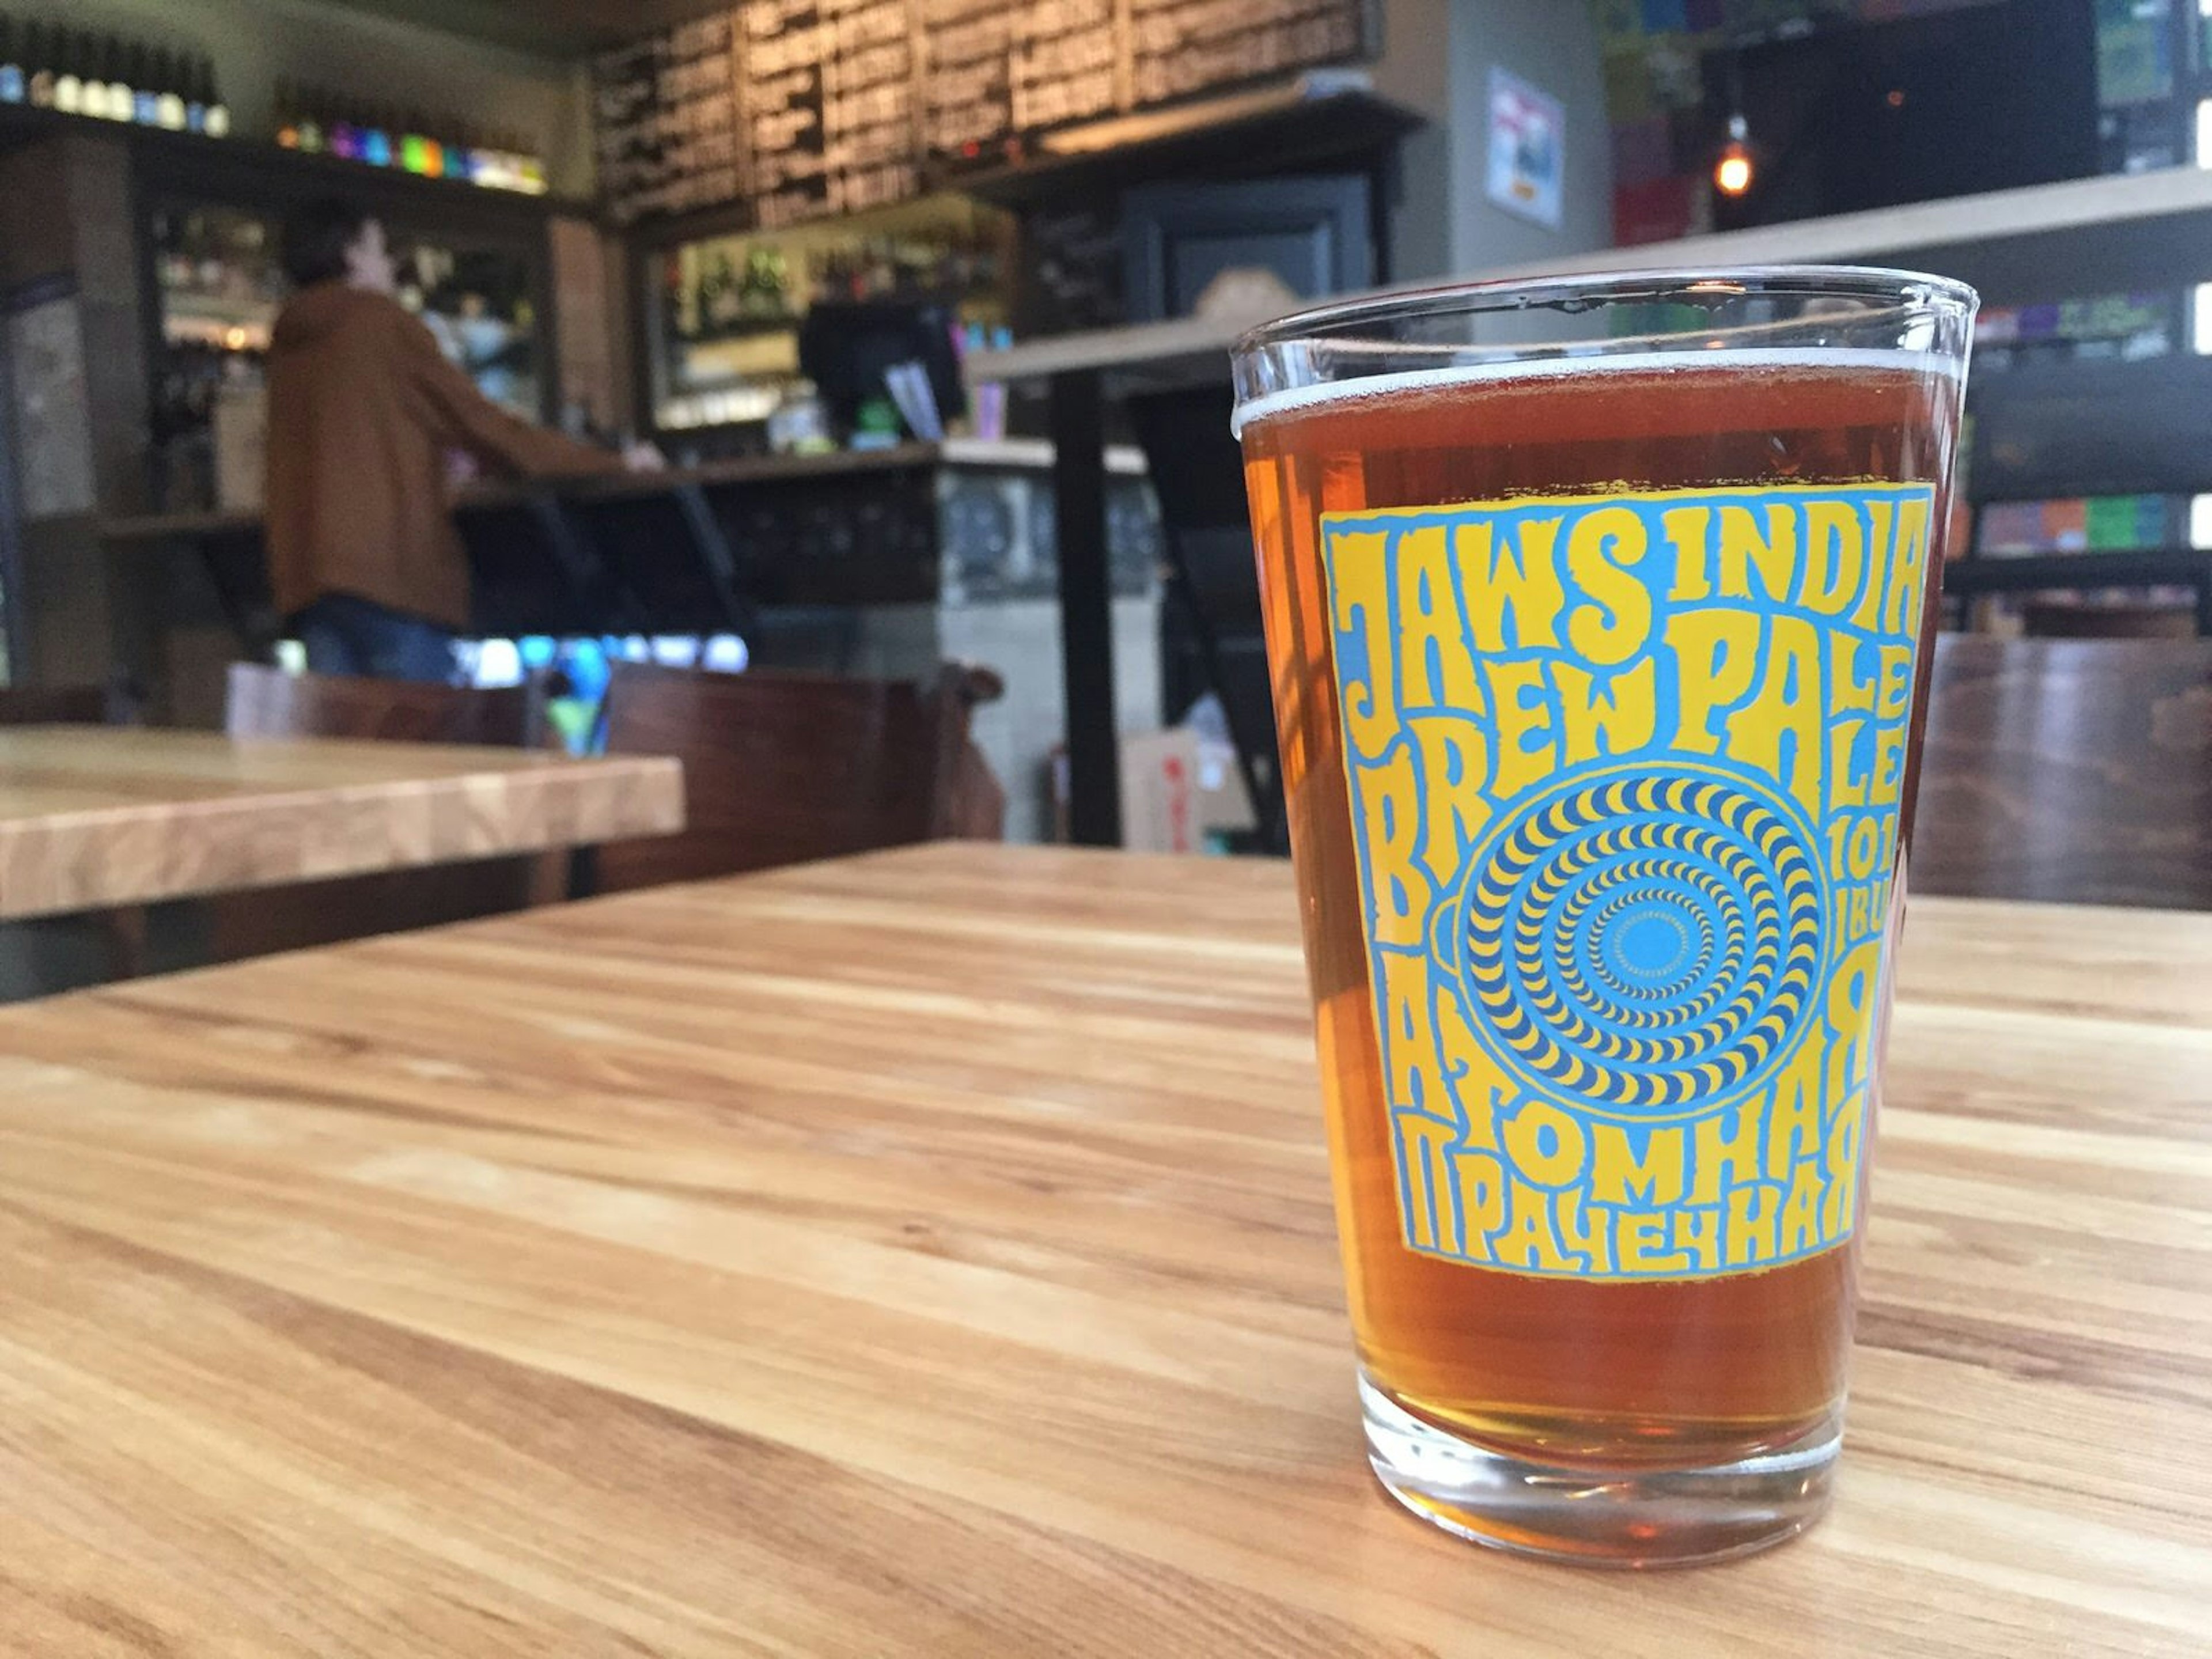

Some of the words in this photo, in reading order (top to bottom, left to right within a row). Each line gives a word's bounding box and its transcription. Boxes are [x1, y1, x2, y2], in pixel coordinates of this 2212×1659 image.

[1329, 507, 1653, 759] JAWS
[1662, 498, 1928, 641] INDIA
[1355, 656, 1655, 946] BREW
[1826, 813, 1896, 882] 101
[1381, 940, 1880, 1204] АТОМНАЯ
[1396, 1088, 1864, 1272] ПРАЧЕЧНАЯ
